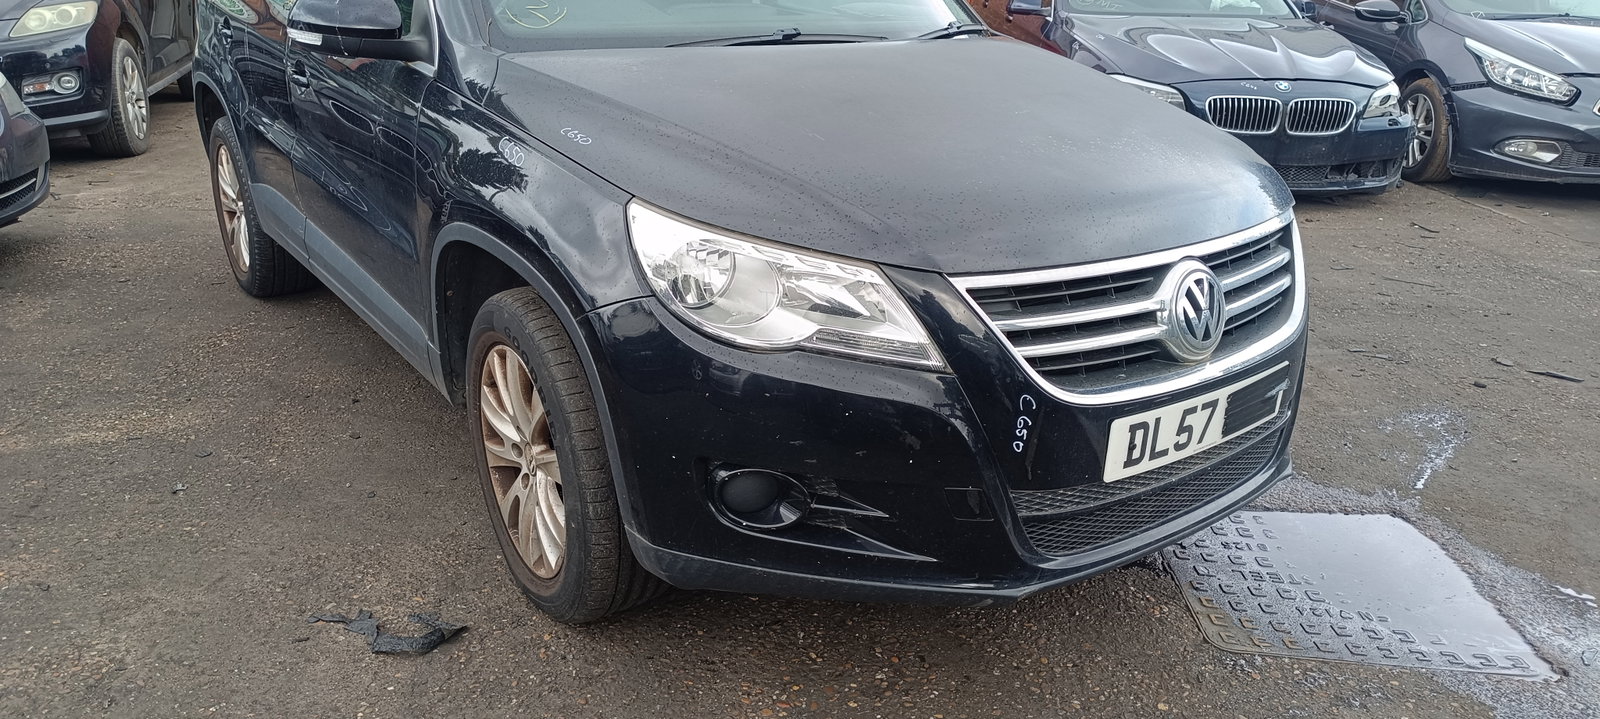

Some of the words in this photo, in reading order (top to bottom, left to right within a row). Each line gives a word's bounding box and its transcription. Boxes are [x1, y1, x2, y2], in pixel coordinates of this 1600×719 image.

[499, 136, 525, 166] C650
[560, 127, 592, 145] C650
[1122, 397, 1220, 469] DL57
